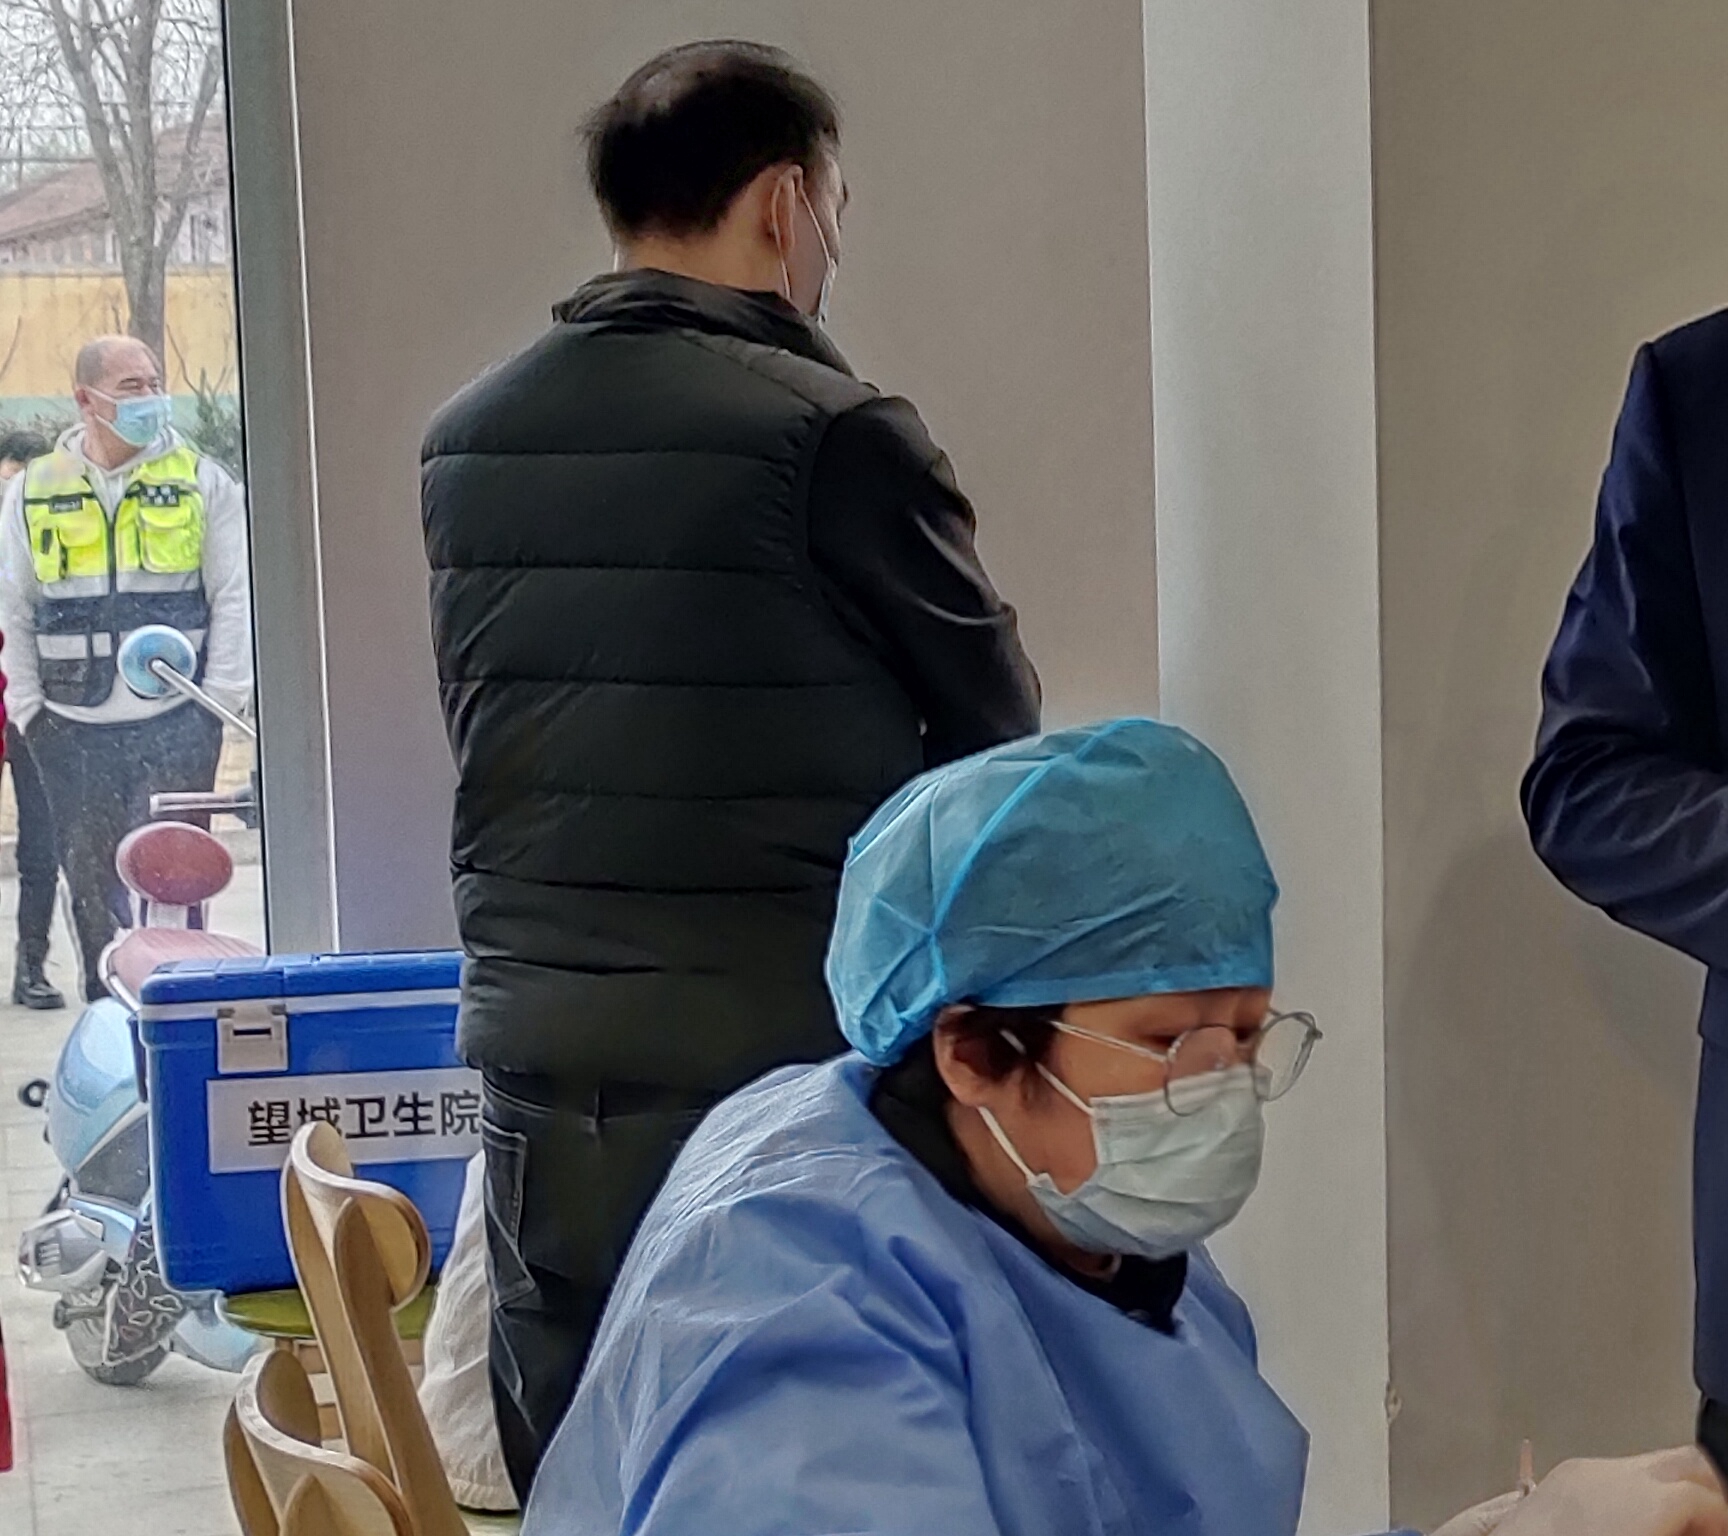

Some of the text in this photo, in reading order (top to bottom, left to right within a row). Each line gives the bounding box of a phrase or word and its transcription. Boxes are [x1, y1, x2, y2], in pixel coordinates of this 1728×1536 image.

[248, 1090, 480, 1146] 望城卫生院
